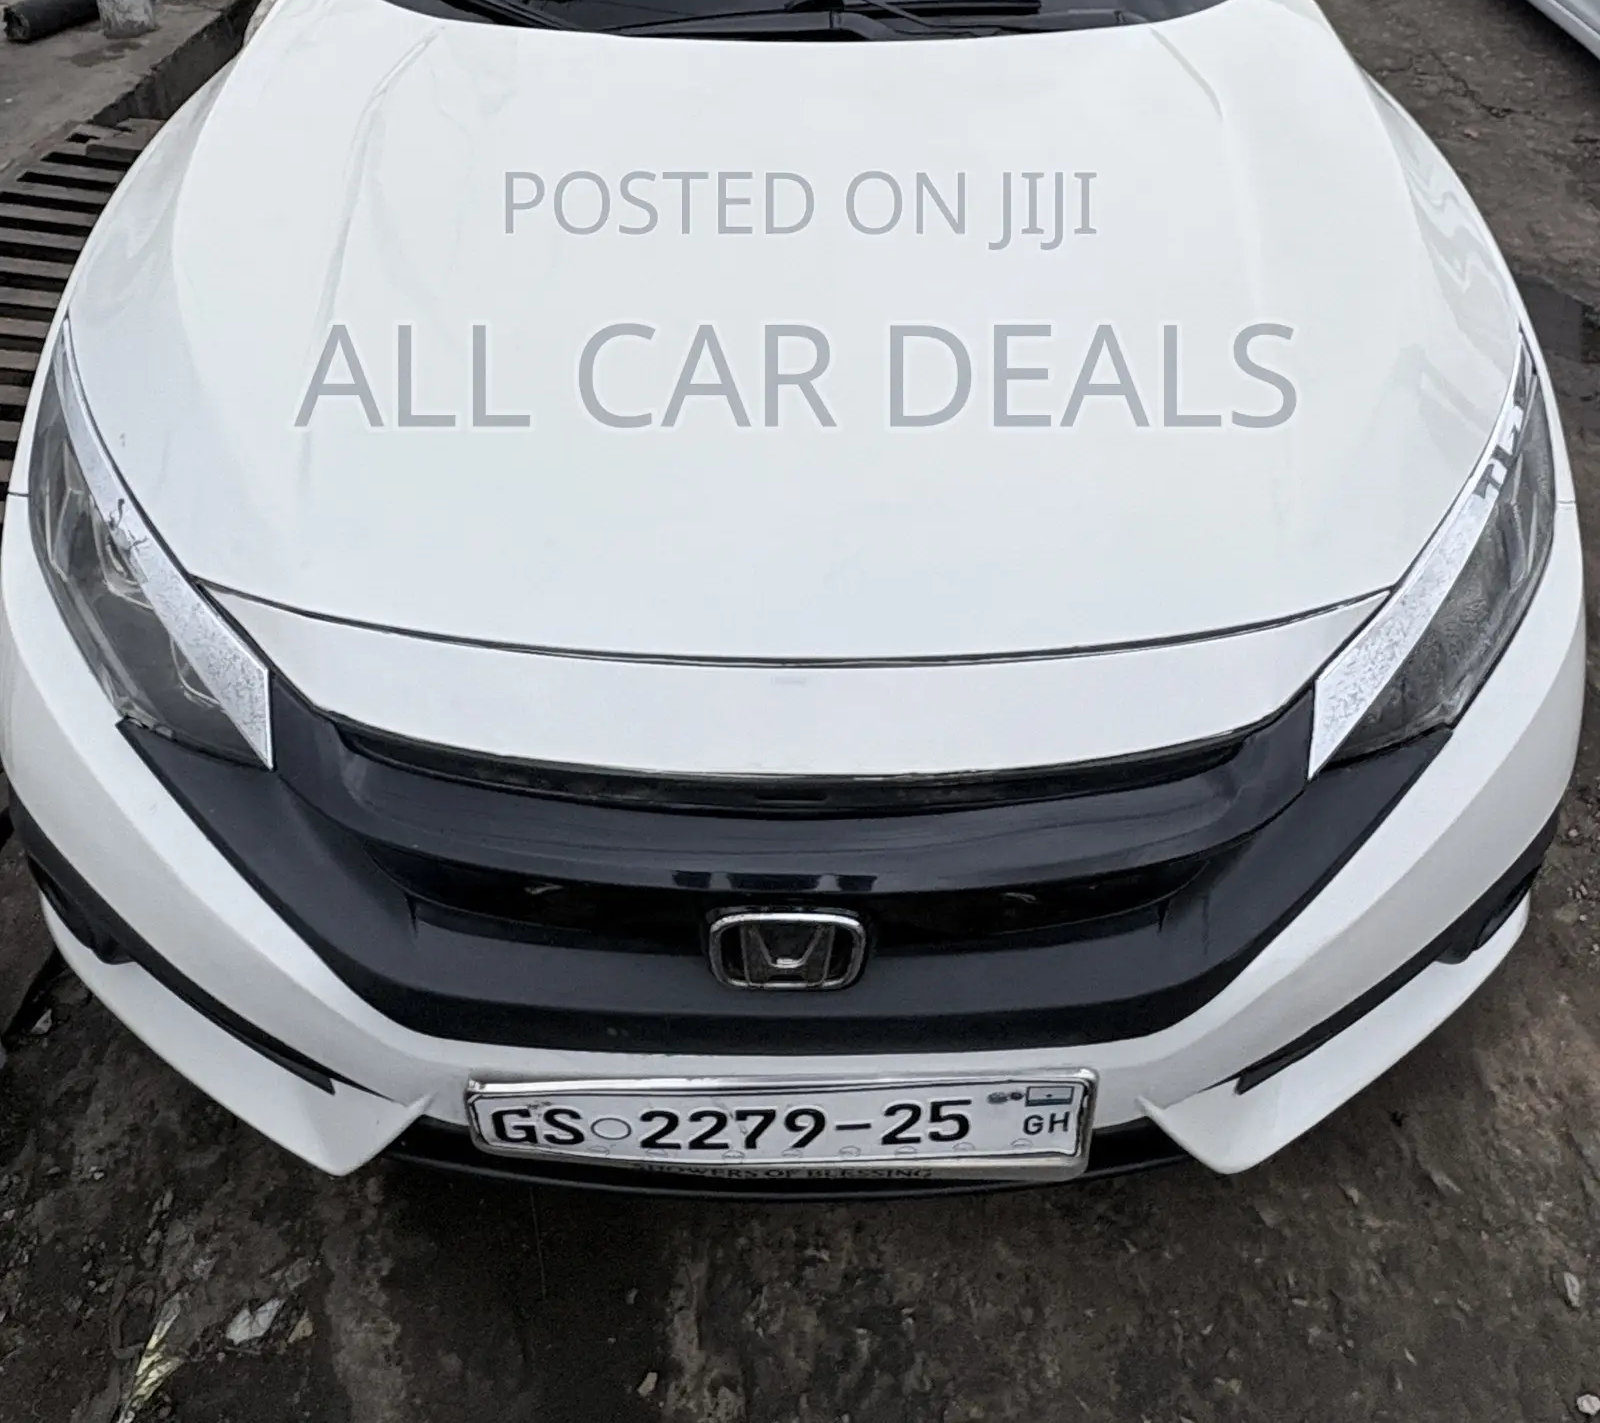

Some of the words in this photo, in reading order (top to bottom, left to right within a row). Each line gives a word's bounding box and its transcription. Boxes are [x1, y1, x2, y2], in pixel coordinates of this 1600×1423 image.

[491, 1107, 586, 1147] GS
[638, 1098, 973, 1151] 2279-25
[1022, 1110, 1071, 1136] GH
